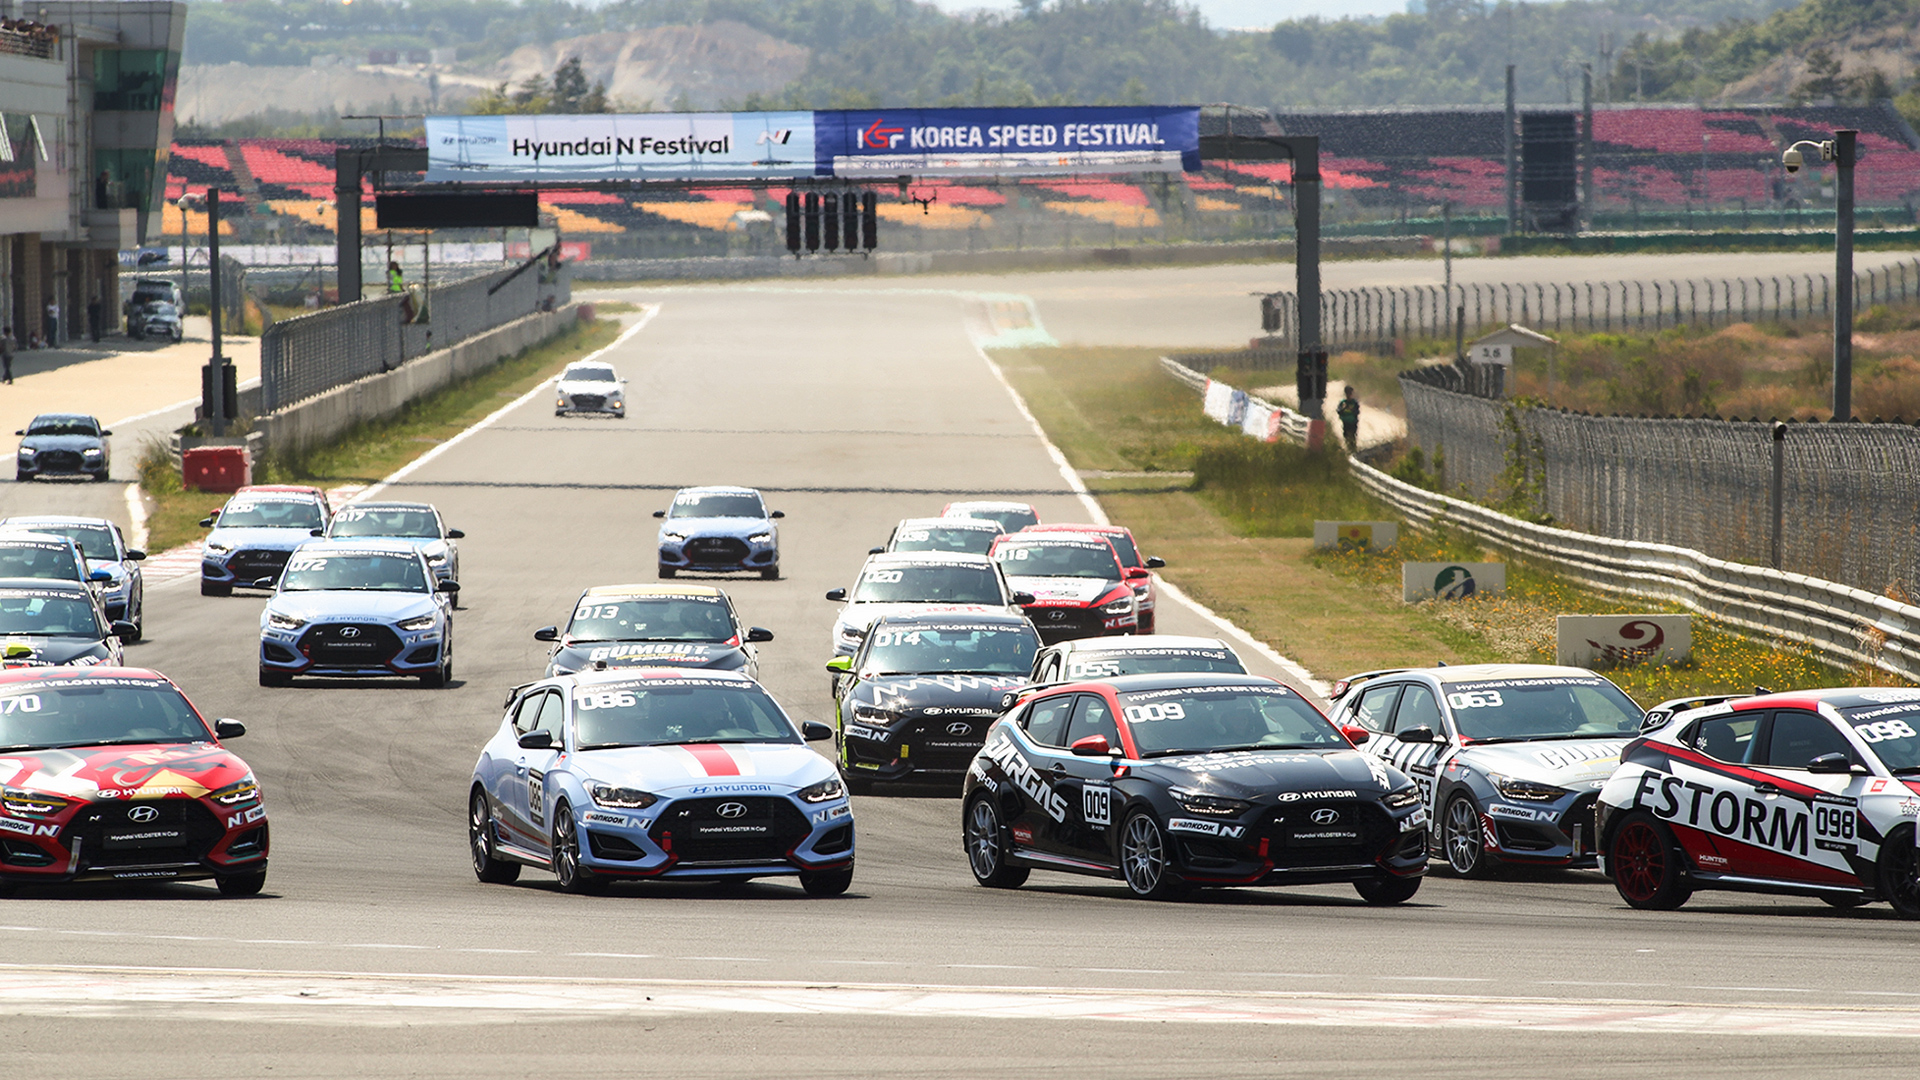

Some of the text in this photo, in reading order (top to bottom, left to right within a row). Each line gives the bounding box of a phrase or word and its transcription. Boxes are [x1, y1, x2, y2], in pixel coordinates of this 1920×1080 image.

[911, 126, 984, 148] KOREA
[988, 125, 1058, 147] SPEED
[1063, 123, 1165, 146] FESTIVAL
[512, 136, 730, 160] Hyundai N Festival
[994, 549, 1029, 562] 018
[289, 559, 327, 572] 072
[863, 570, 904, 583] 020
[574, 605, 619, 620] 013
[998, 625, 1021, 633] Cup
[874, 631, 921, 647] 014
[1203, 651, 1226, 660] Cup
[1069, 660, 1120, 677] 055
[46, 679, 118, 688] VELOSTER
[118, 679, 130, 687] N
[131, 680, 159, 688] Cup
[639, 679, 710, 687] VELOSTER
[722, 681, 753, 690] Cup
[1456, 681, 1507, 691] Hyundai
[1507, 678, 1569, 687] VELOSTER
[578, 690, 636, 711] 086
[1127, 688, 1182, 702] Hyundai
[1182, 686, 1248, 695] VELOSTER
[1261, 686, 1288, 695] Cup
[1447, 690, 1504, 709] 063
[0, 694, 42, 714] 70
[1125, 702, 1186, 724] 009
[1851, 705, 1901, 721] Hyundai
[1854, 719, 1917, 743] 098
[123, 786, 182, 796] HYUNDAI
[714, 784, 771, 792] HYUNDAI
[1302, 790, 1357, 799] HYUNDAI
[1085, 789, 1109, 821] 009
[1816, 806, 1855, 840] 098
